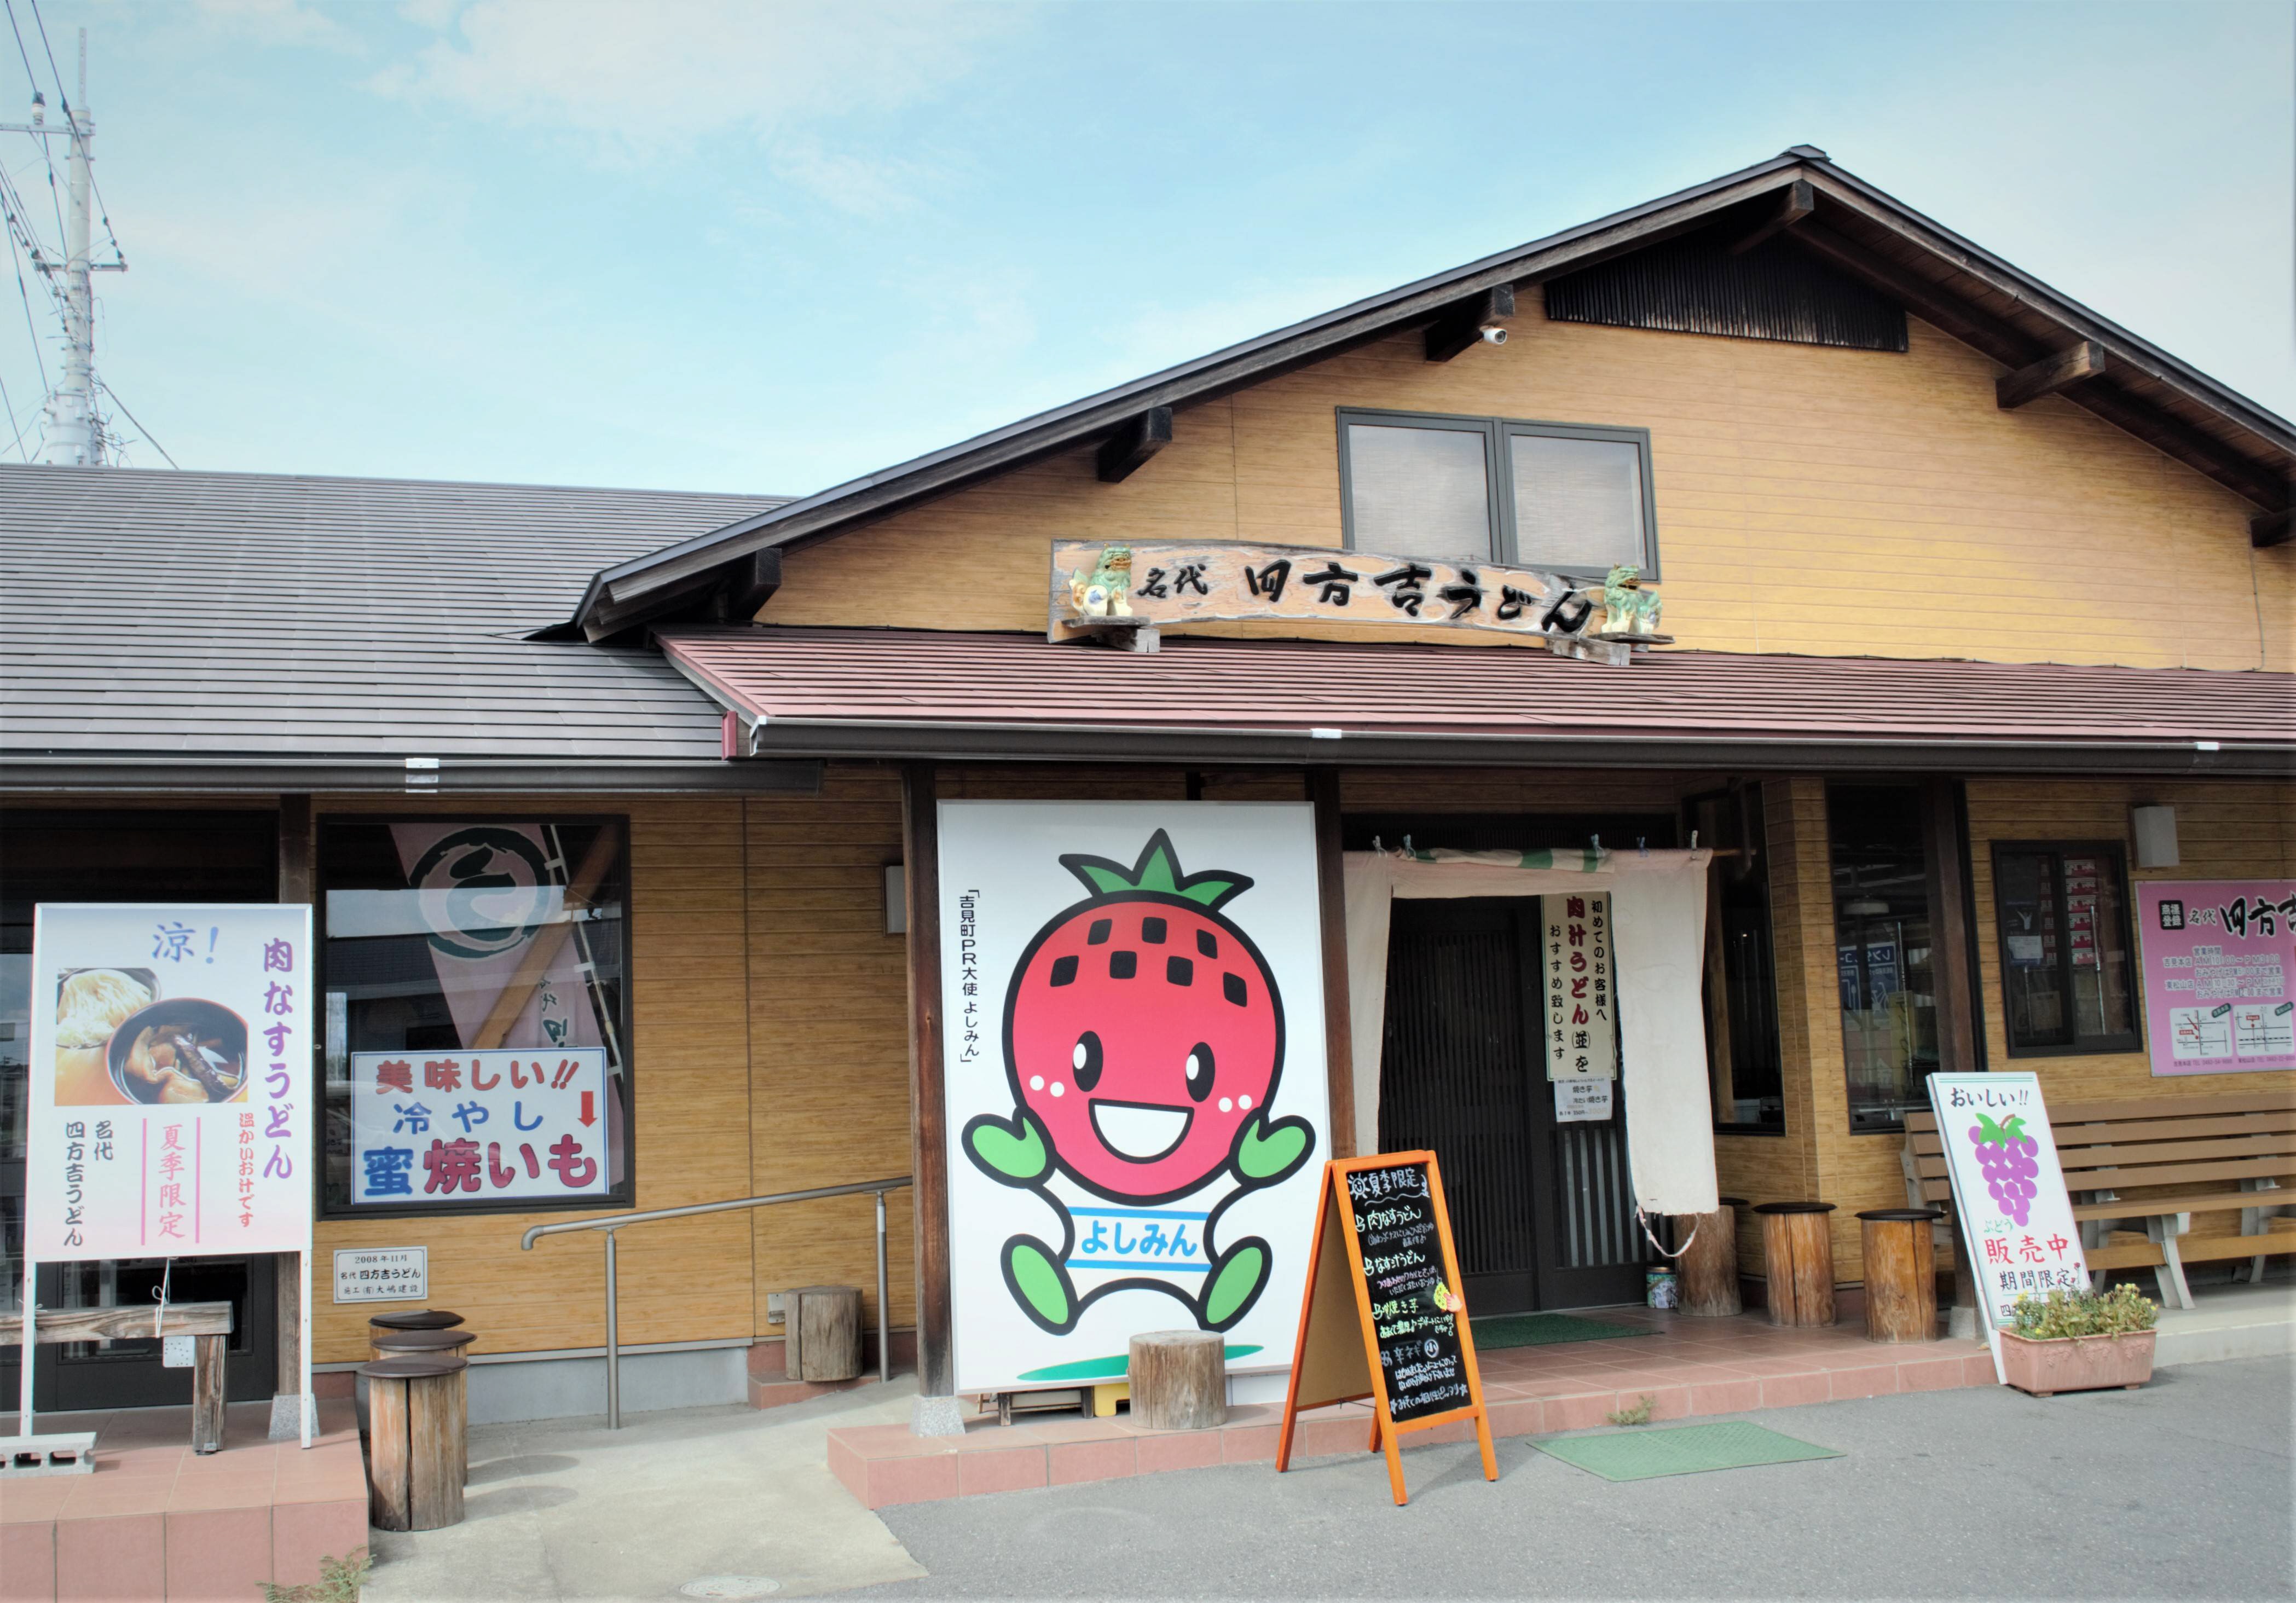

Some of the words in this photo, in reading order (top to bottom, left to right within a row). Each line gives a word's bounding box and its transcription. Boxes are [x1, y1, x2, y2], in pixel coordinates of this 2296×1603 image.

[1137, 563, 1208, 598] 名代
[1244, 560, 1593, 633] 四方吉うどん
[2189, 908, 2217, 925] 名代
[1591, 900, 1607, 1021] 初めてのお客様へ
[2164, 958, 2191, 967] 吉見本店
[1549, 924, 1565, 1060] おすすめ致します
[2166, 980, 2194, 989] 東松山店
[263, 938, 293, 1179] 肉なすうどん
[392, 1100, 544, 1135] 冷やし
[94, 1121, 113, 1160] 名代
[159, 1124, 186, 1239] 夏季限定
[238, 1112, 255, 1228] 温かいお汁です
[363, 1134, 597, 1196] 蜜焼いも
[1369, 1167, 1419, 1197] 夏季限定
[64, 1122, 85, 1247] 四方吉うどん
[1367, 1205, 1421, 1230] 肉なすうどん
[1082, 1220, 1197, 1257] よしみん
[1985, 1234, 2069, 1265] 販売中
[355, 1254, 407, 1264] 2008年11月
[360, 1268, 421, 1280] 四方吉うどん
[1999, 1269, 2071, 1291] 期間限定
